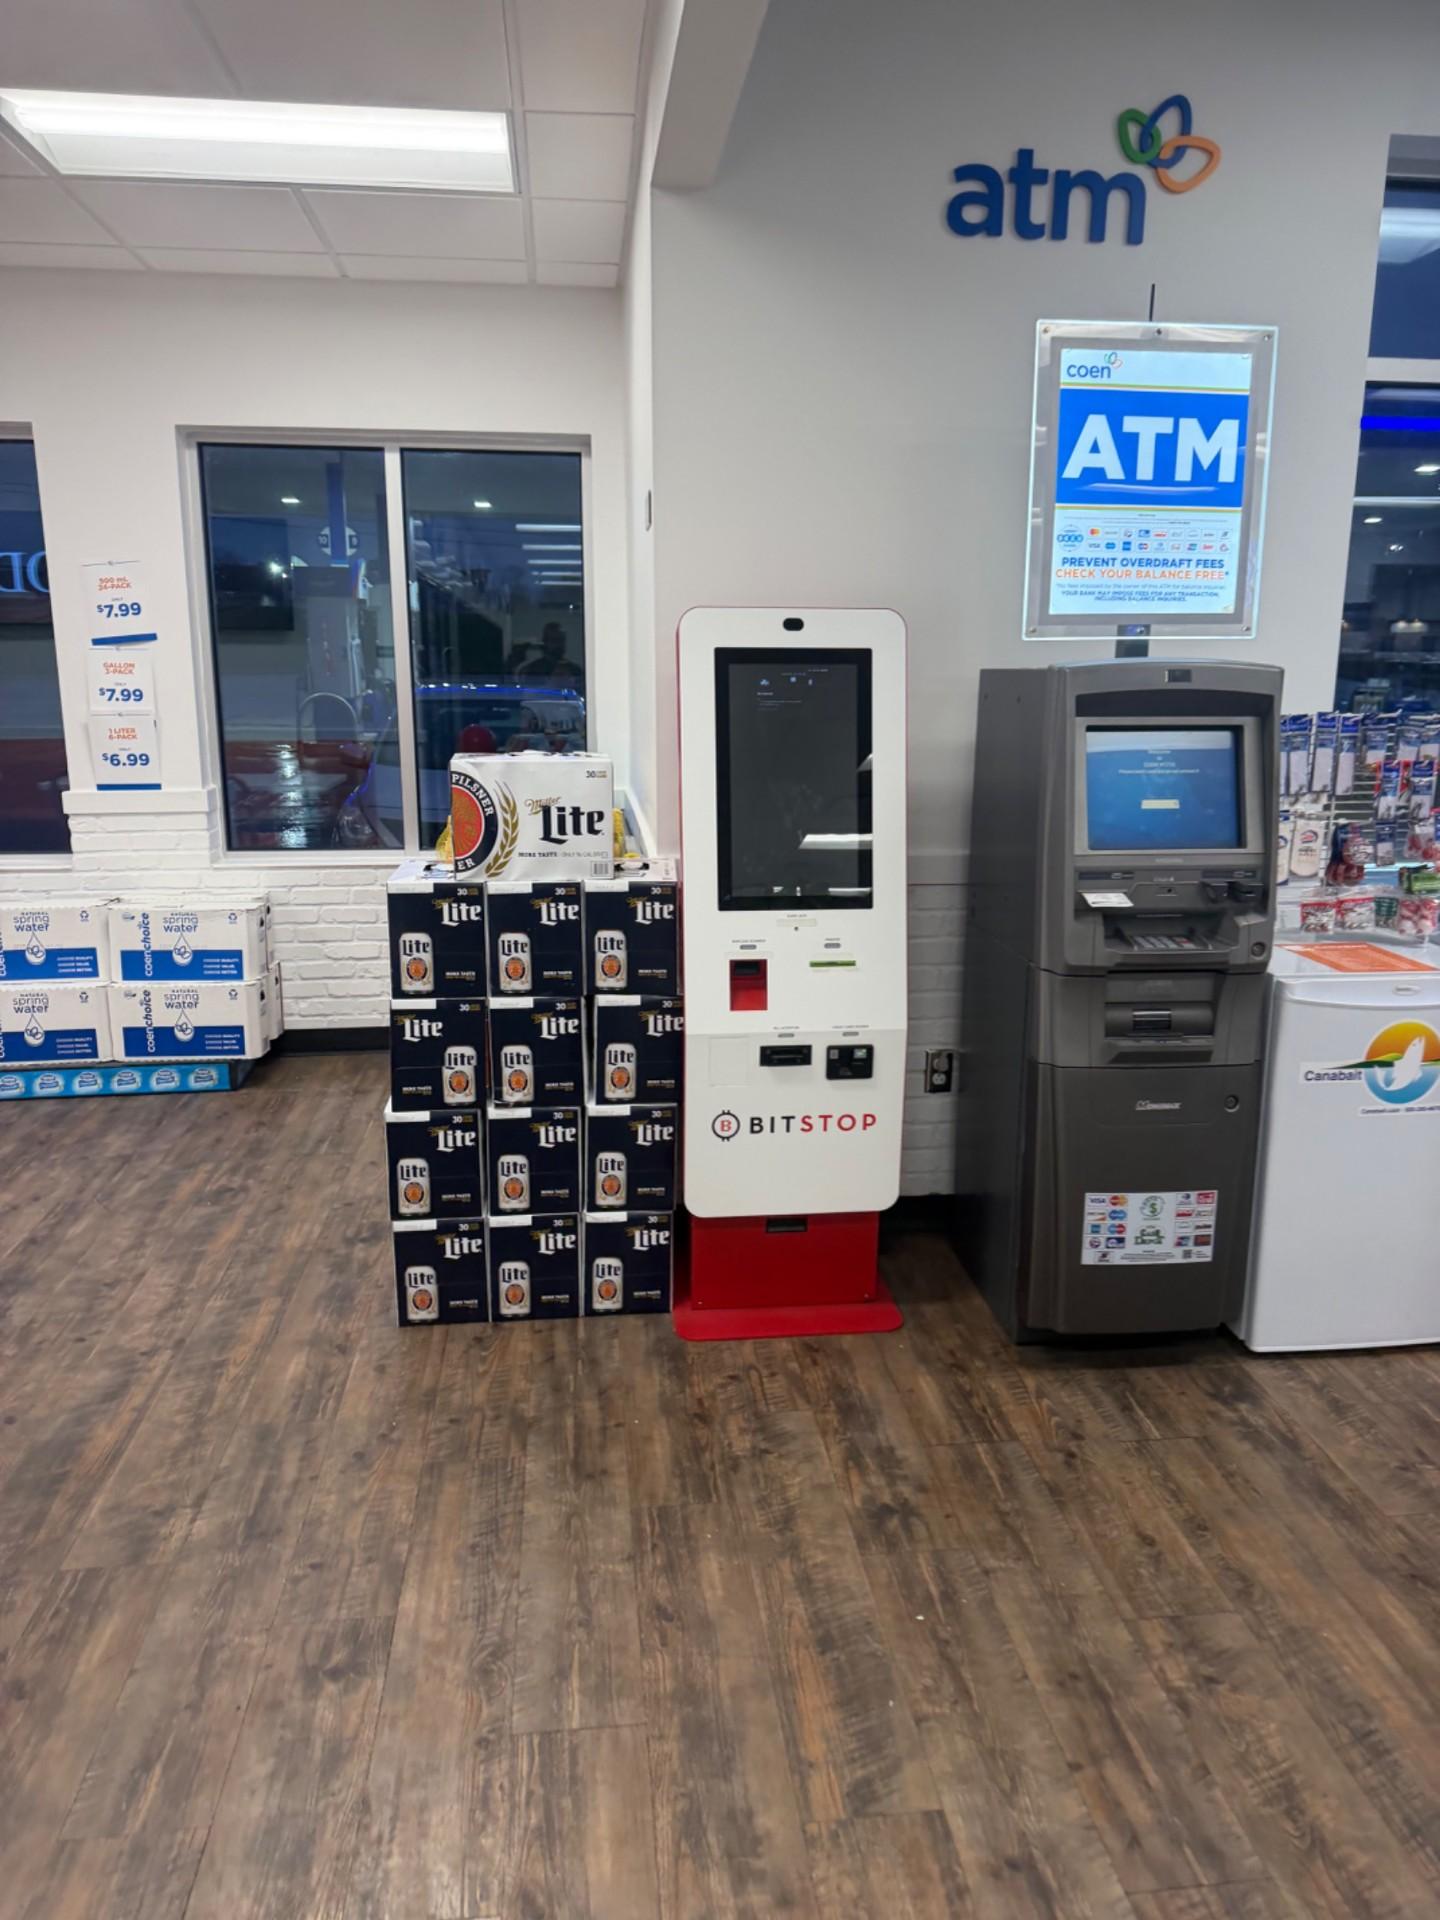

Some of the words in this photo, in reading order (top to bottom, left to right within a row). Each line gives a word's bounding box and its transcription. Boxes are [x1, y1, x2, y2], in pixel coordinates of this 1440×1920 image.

[946, 147, 1147, 246] atm
[1066, 363, 1112, 379] coen
[1061, 413, 1240, 484] ATM
[1062, 556, 1117, 568] PREVENT
[1120, 558, 1193, 568] OVERDRAFT
[1195, 559, 1225, 569] FEES
[1056, 568, 1096, 578] CHECK
[1099, 569, 1132, 579] YOUR
[1136, 570, 1192, 580] BALANCE
[96, 601, 142, 618] $7.99
[98, 687, 144, 702] $7.99
[102, 752, 150, 767] $6.99
[452, 773, 494, 816] PILSNER
[538, 804, 606, 846] Lite
[13, 914, 50, 924] spring
[163, 916, 199, 926] spring
[441, 902, 482, 926] Lite
[540, 902, 580, 926] Lite
[634, 901, 675, 925] Lite
[14, 922, 50, 932] water
[164, 924, 198, 932] water
[138, 912, 153, 976] coenchoice
[402, 940, 430, 956] Lite
[501, 940, 528, 956] Lite
[596, 937, 624, 954] Lite
[12, 996, 50, 1006] spring
[164, 992, 200, 1001] spring
[164, 1000, 199, 1009] water
[13, 1004, 48, 1014] water
[140, 989, 156, 1053] coenchoice
[540, 1016, 580, 1040] Lite
[646, 1014, 685, 1038] Lite
[402, 1018, 444, 1042] Lite
[446, 1052, 475, 1070] Lite
[503, 1050, 530, 1068] Lite
[607, 1049, 634, 1066] Lite
[1304, 1069, 1363, 1082] Canabait
[750, 1114, 877, 1134] BITSTOP
[436, 1128, 477, 1152] Lite
[538, 1124, 576, 1148] Lite
[636, 1122, 674, 1146] Lite
[400, 1164, 426, 1182] Lite
[500, 1160, 528, 1178] Lite
[598, 1158, 624, 1174] Lite
[443, 1236, 483, 1260] Lite
[538, 1232, 576, 1255] Lite
[632, 1228, 670, 1251] Lite
[501, 1267, 528, 1284] Lite
[595, 1263, 621, 1279] Lite
[408, 1272, 434, 1288] Lite
